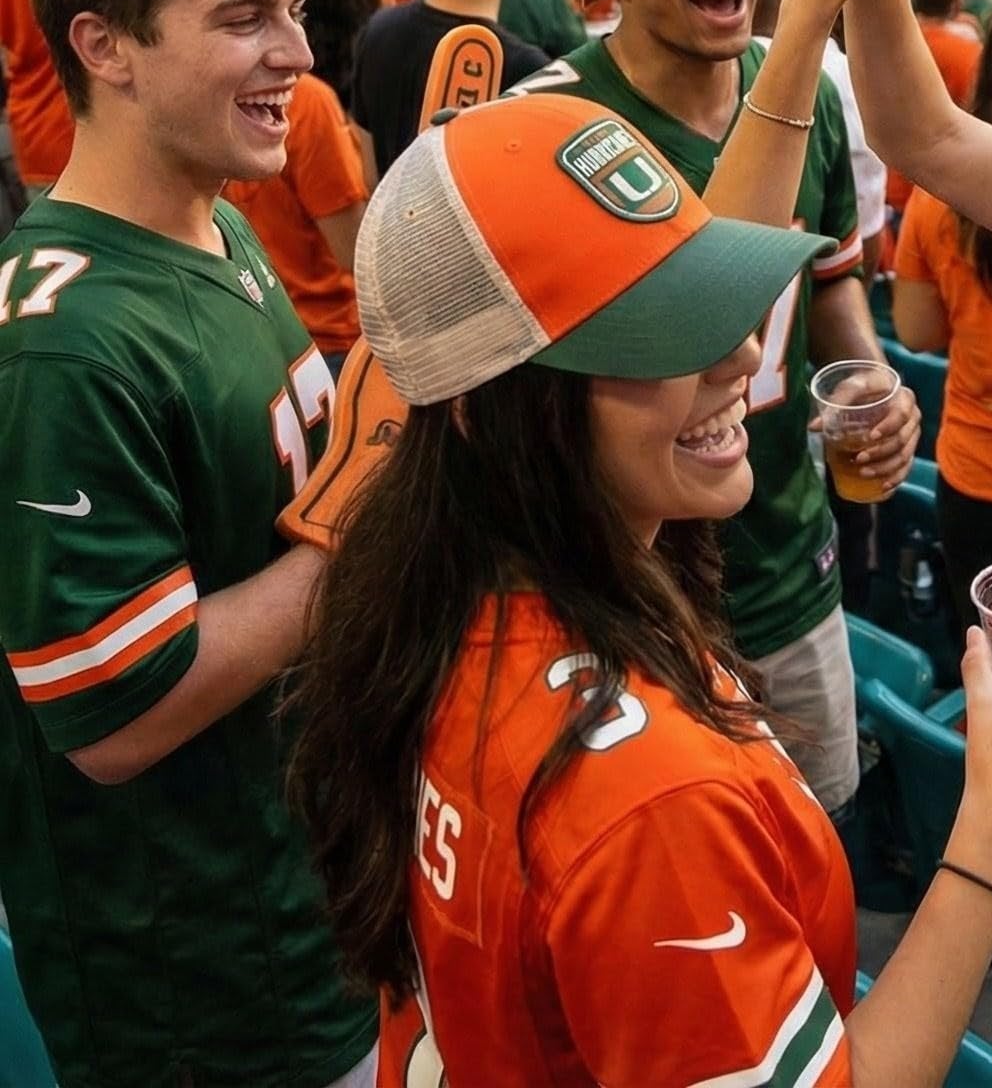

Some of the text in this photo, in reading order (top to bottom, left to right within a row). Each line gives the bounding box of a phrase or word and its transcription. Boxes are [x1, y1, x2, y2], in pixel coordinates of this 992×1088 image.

[608, 155, 663, 202] U
[0, 247, 91, 327] 17
[415, 770, 462, 901] ES
